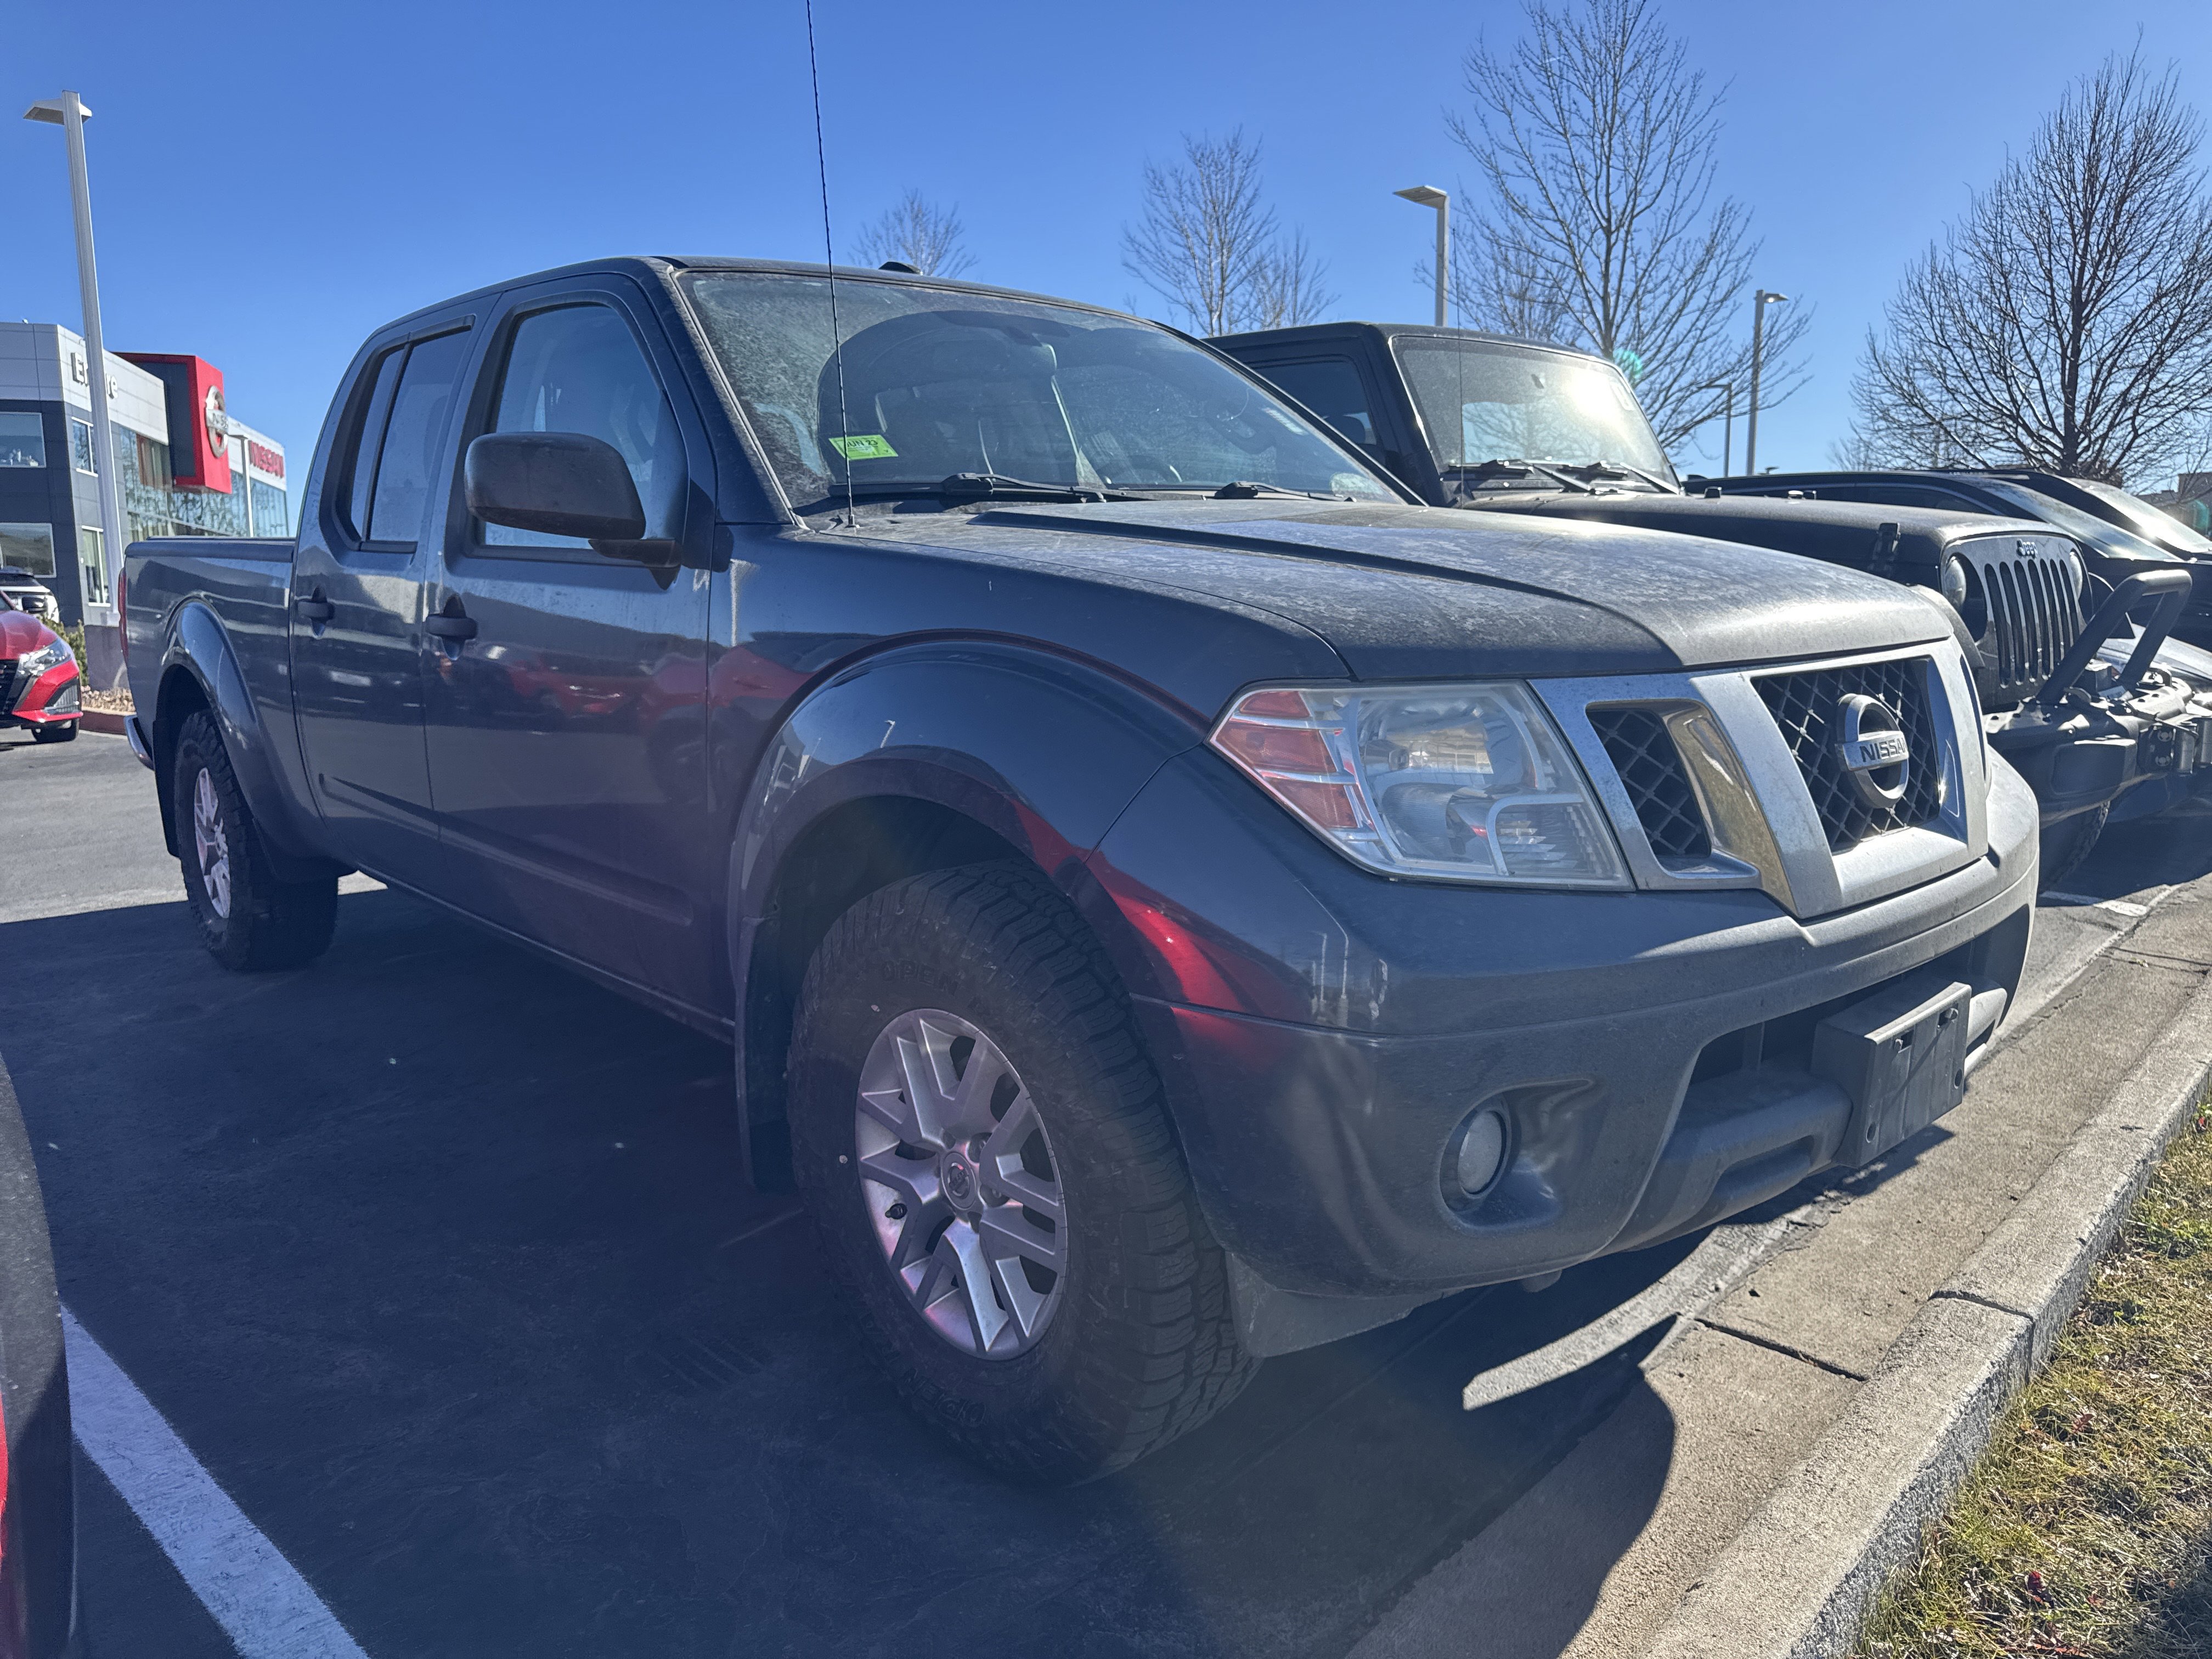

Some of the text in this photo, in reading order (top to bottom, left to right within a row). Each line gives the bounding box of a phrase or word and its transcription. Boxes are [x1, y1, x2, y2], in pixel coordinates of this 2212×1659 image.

[71, 352, 117, 399] Ere
[248, 440, 284, 478] NISSAN
[2017, 538, 2038, 559] Jeep
[880, 959, 960, 996] OPEN
